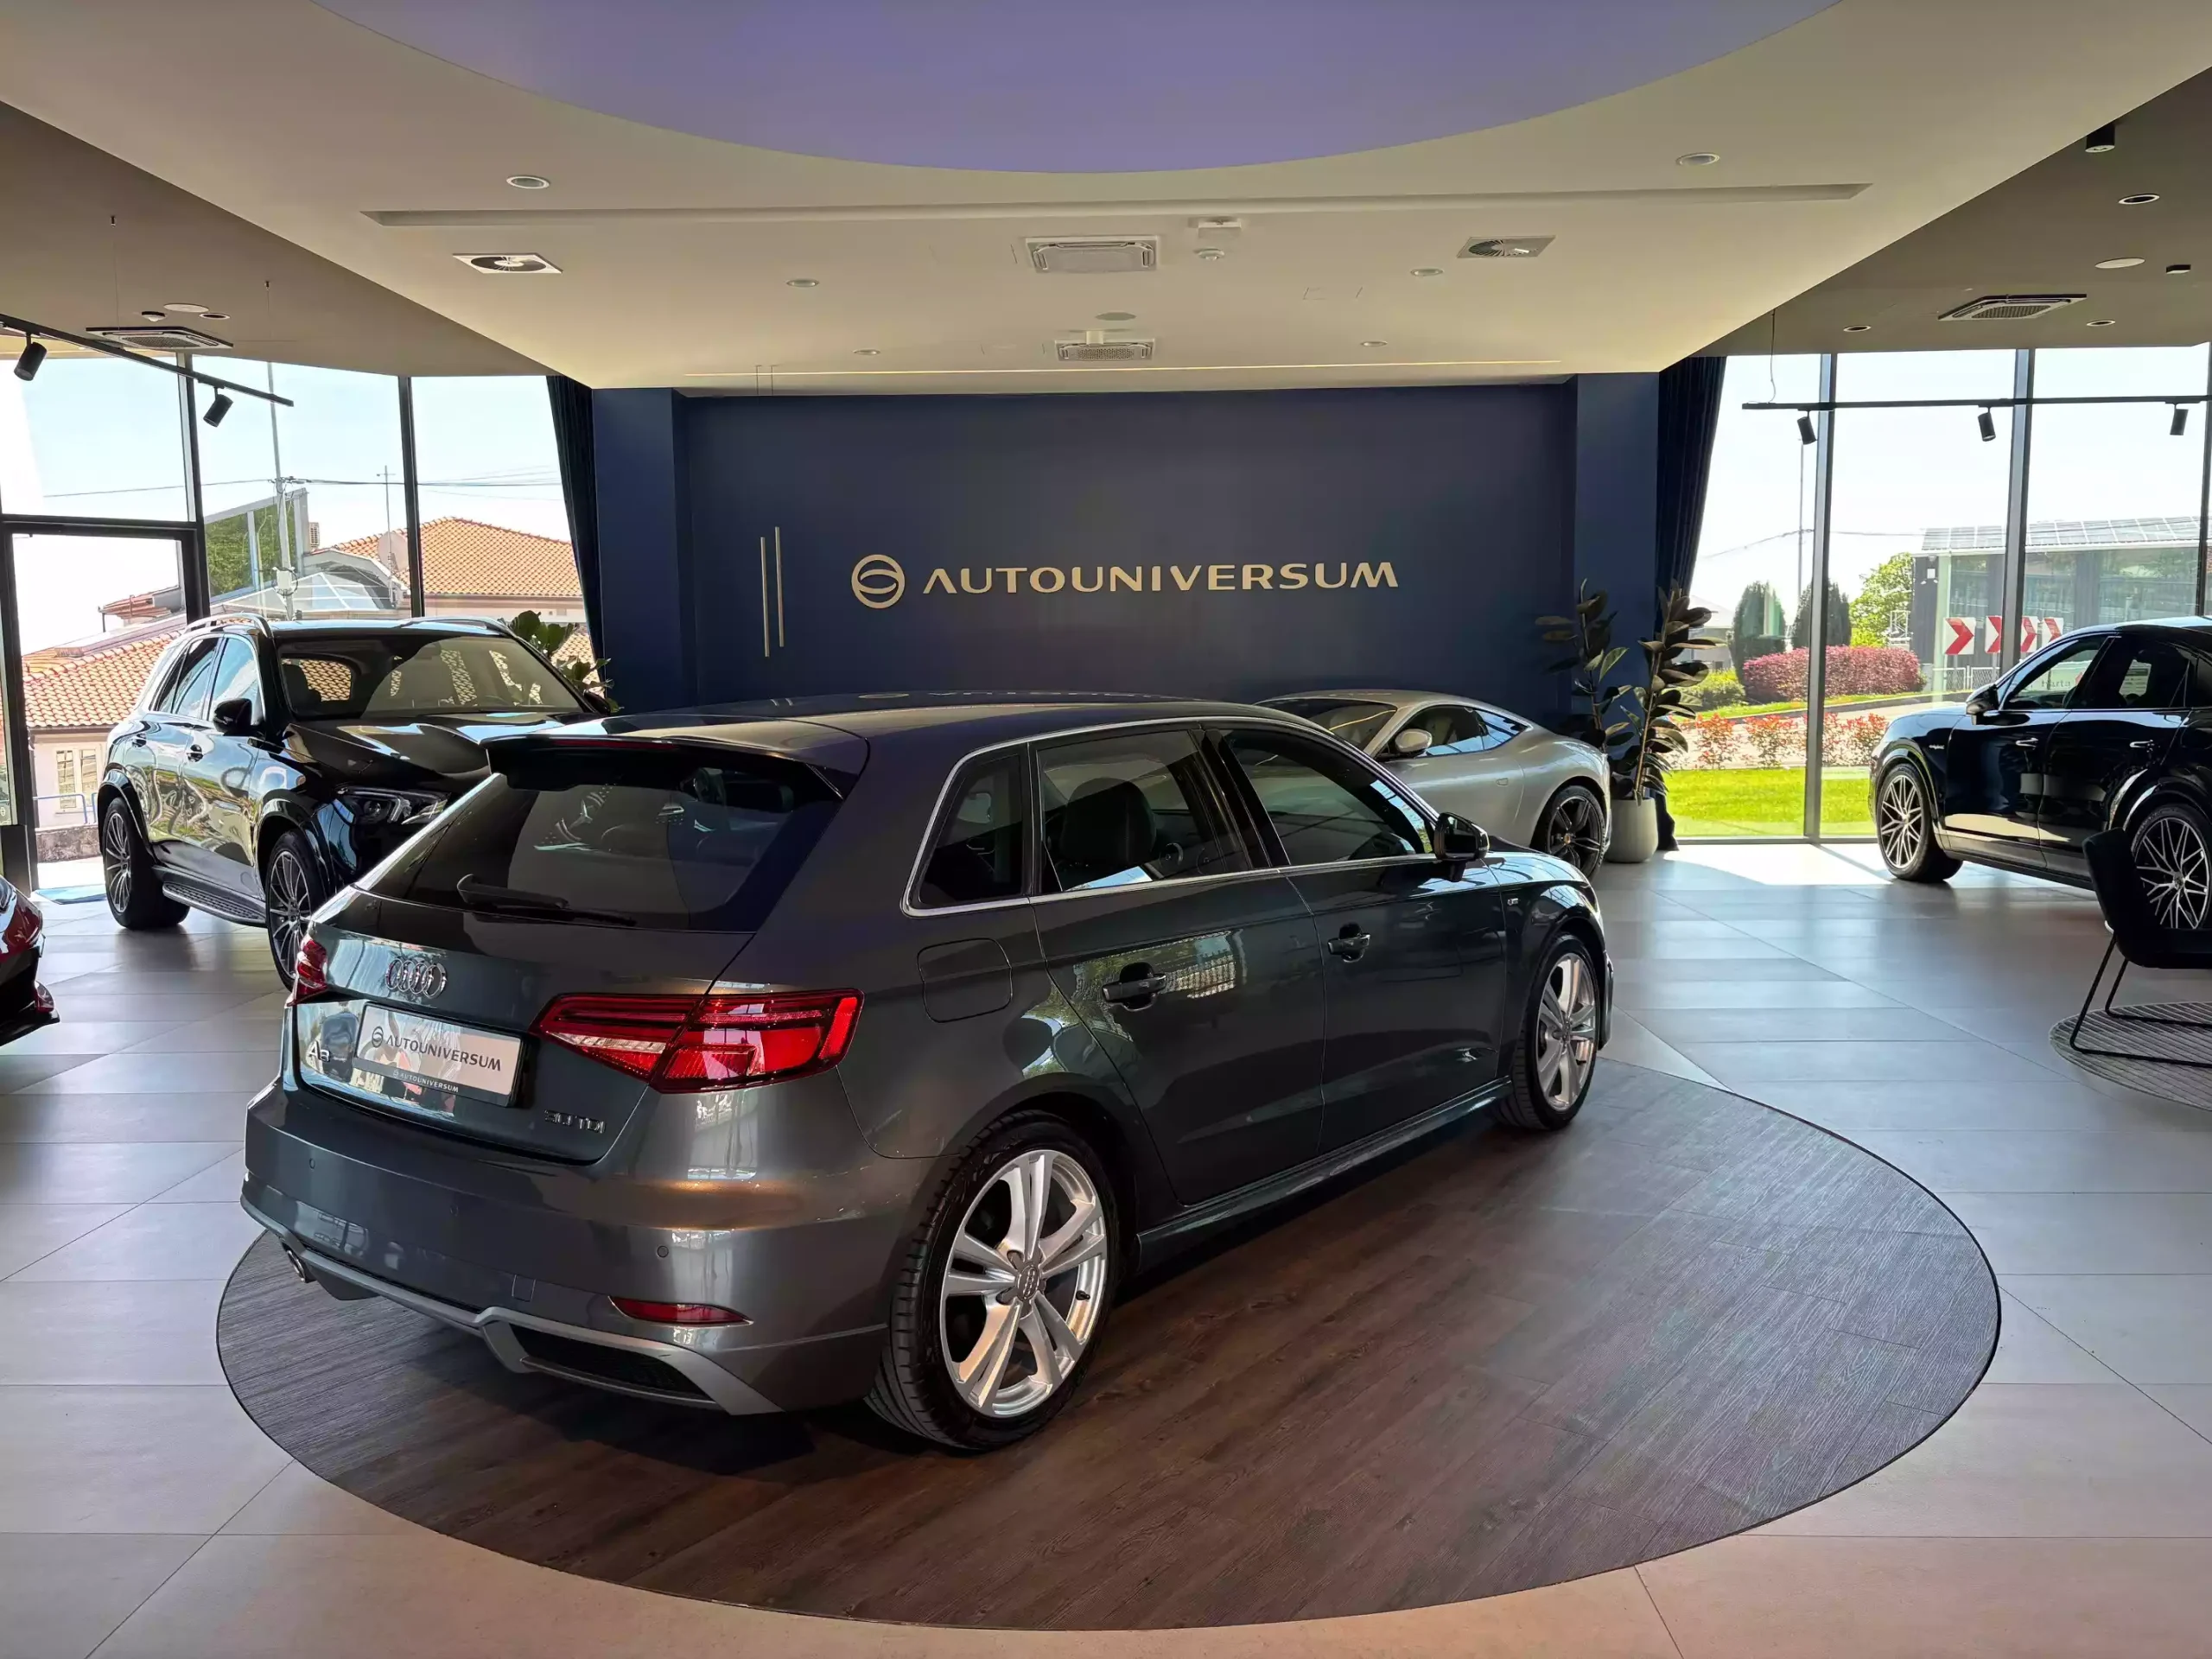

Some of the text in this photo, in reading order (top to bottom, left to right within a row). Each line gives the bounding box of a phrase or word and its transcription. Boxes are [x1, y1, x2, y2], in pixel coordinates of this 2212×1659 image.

[922, 561, 1400, 595] AUTOUNIVERSUM
[385, 1034, 502, 1072] AUTOUNIVERSUM
[399, 1072, 460, 1094] AUTOUNIVERSUM
